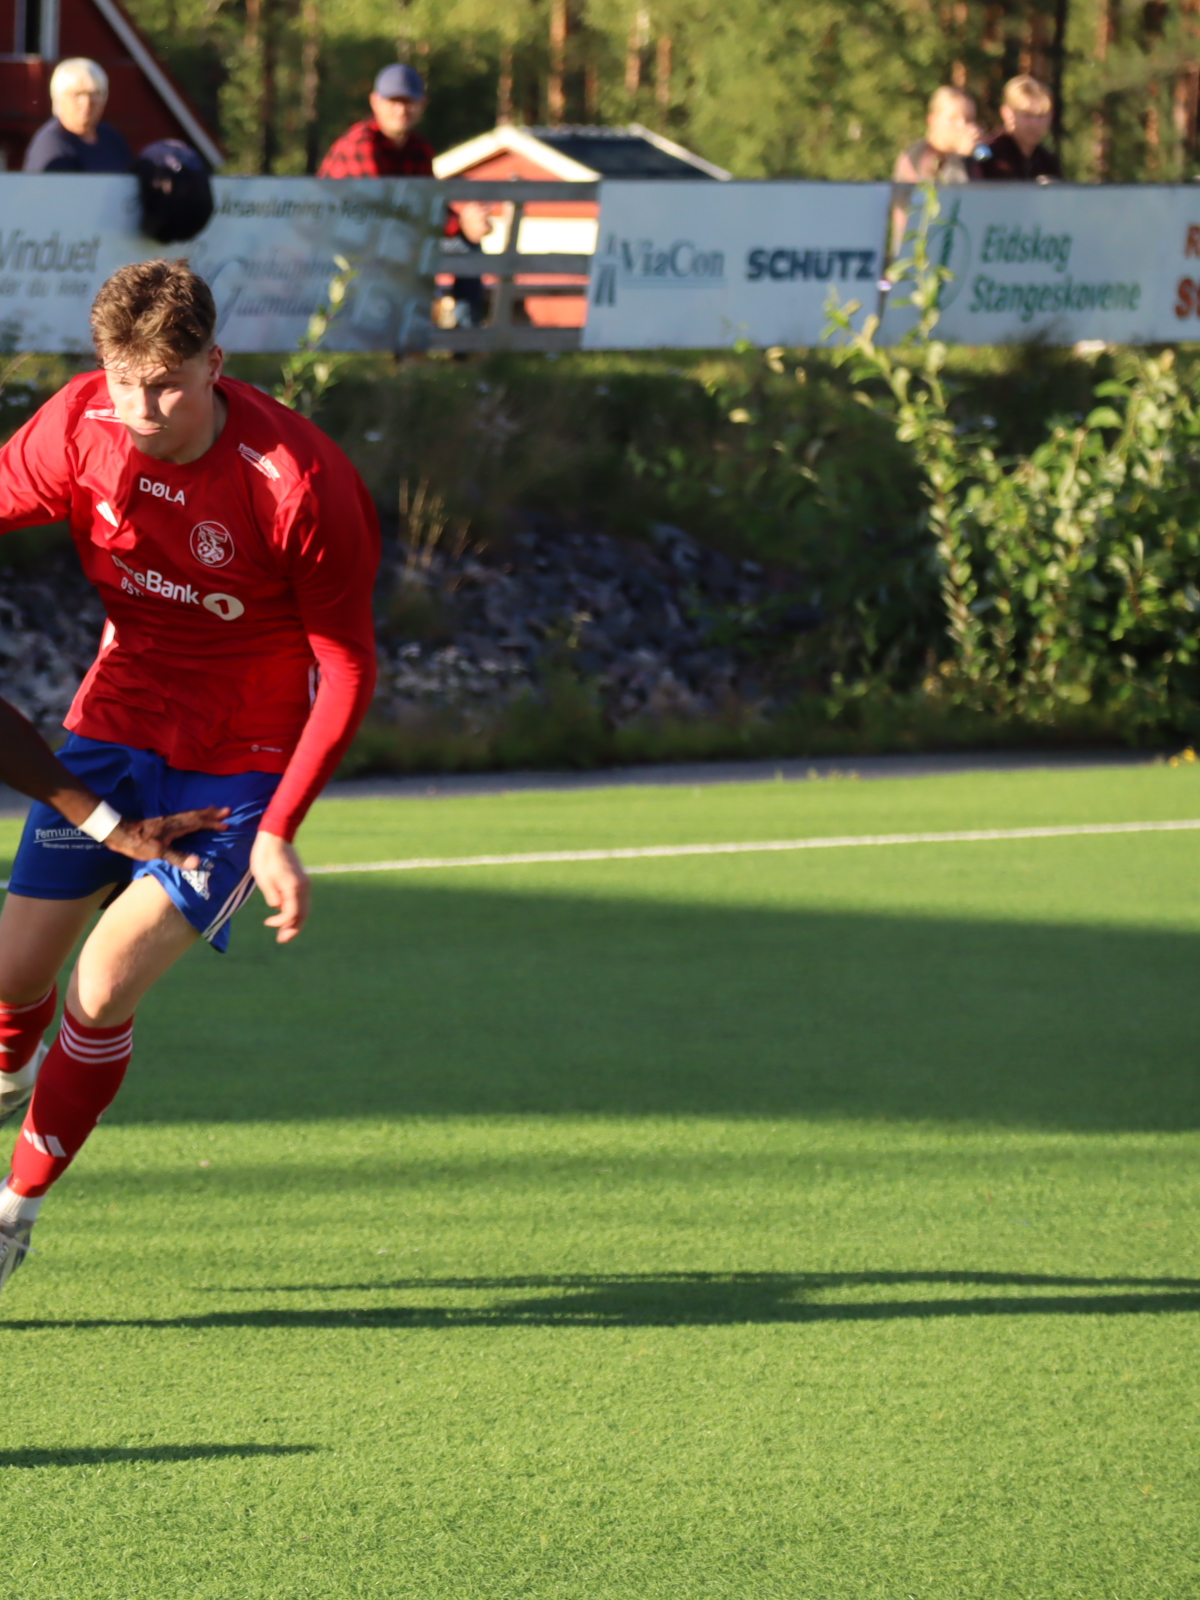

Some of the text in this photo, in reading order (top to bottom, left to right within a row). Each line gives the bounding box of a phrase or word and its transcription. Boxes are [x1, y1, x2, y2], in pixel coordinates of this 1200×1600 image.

[620, 239, 725, 277] ViaCon
[980, 222, 1073, 273] Eidskog
[1173, 277, 1200, 321] S
[139, 477, 185, 506] DØLA
